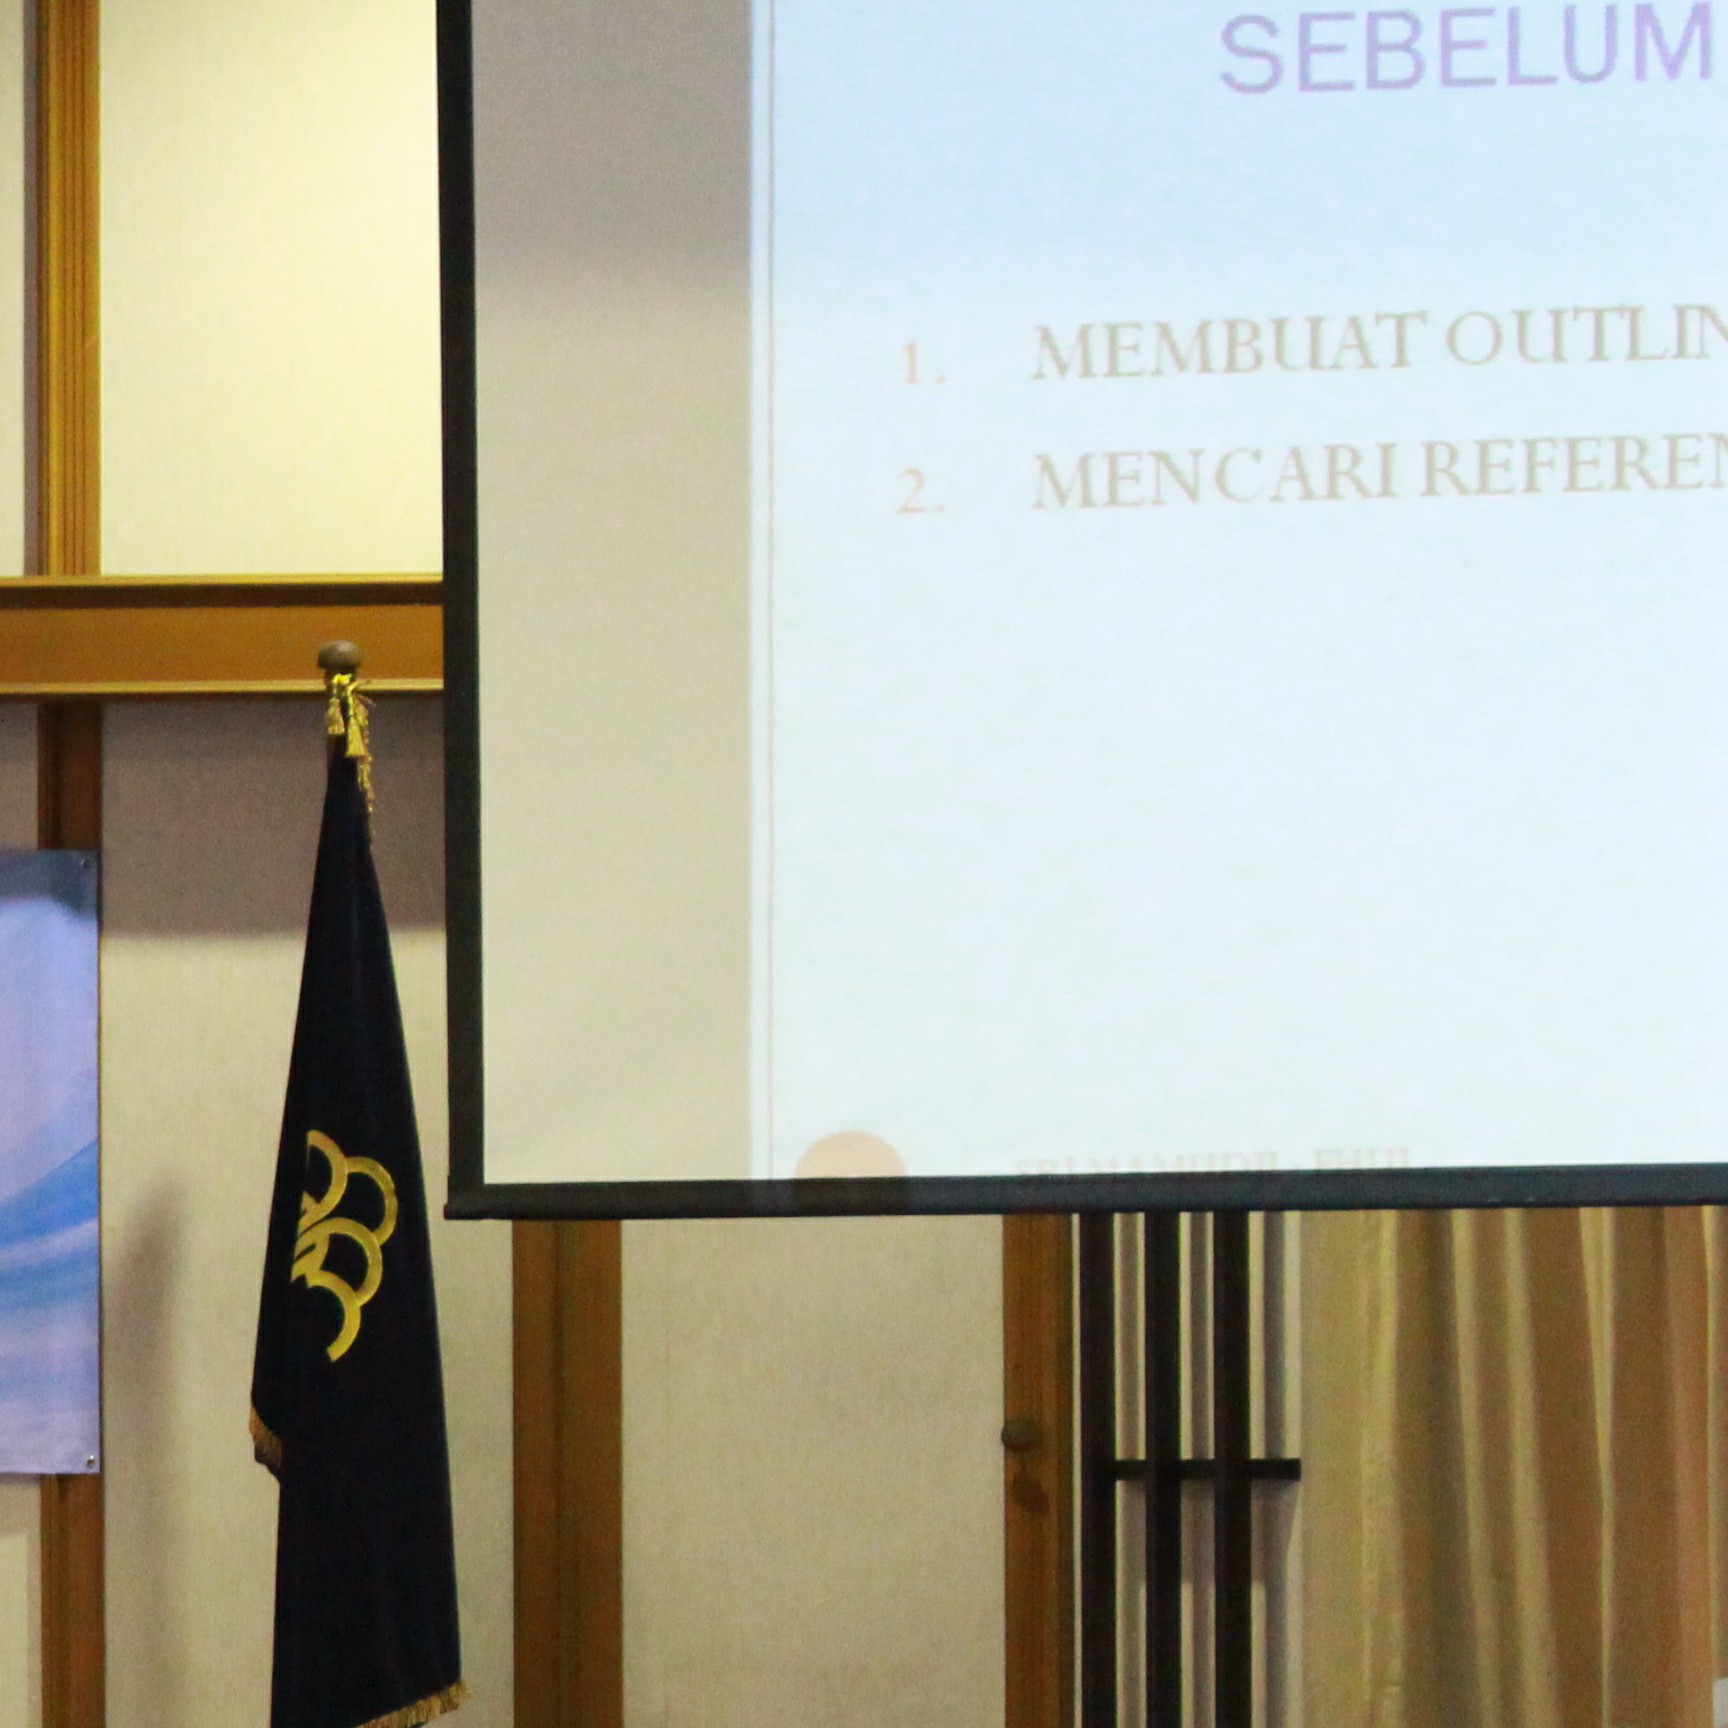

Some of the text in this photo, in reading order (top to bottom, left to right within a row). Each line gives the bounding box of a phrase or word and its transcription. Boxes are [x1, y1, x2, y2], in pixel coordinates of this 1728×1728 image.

[1220, 2, 1713, 95] SEBELUM
[901, 339, 947, 385] 1.
[1031, 308, 1428, 380] MEMBUAT
[896, 468, 947, 514] 2.
[1031, 442, 1399, 511] MENCARI
